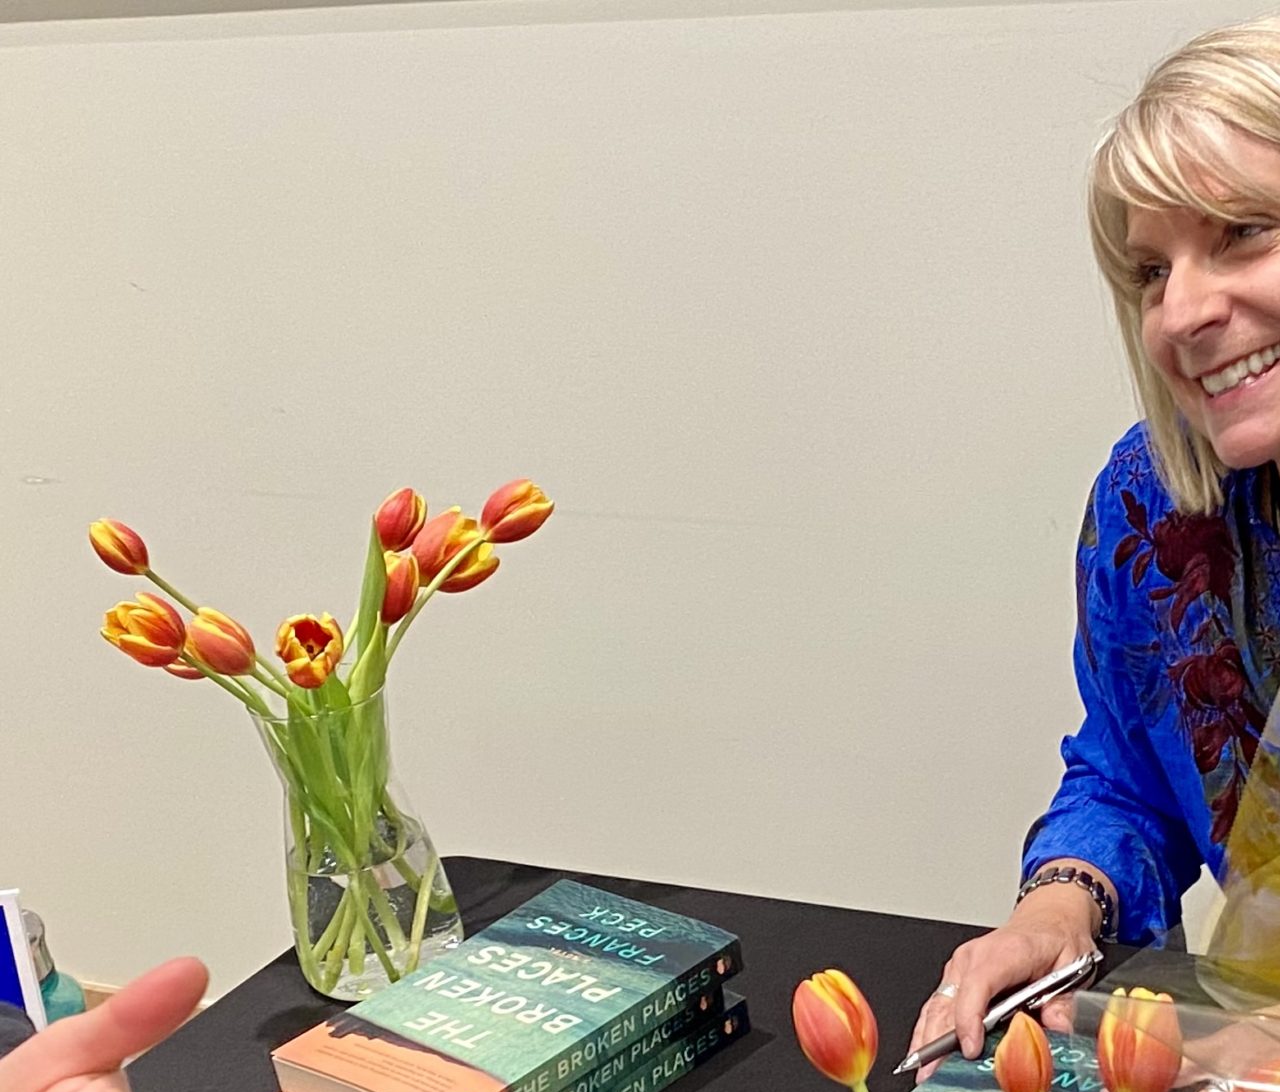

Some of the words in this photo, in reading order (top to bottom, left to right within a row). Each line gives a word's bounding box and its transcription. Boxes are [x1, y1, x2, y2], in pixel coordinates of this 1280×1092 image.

[526, 915, 666, 967] FRANCES
[579, 905, 666, 939] PECK
[413, 970, 583, 1035] BROKEN
[467, 945, 622, 1003] PLACES
[403, 1010, 492, 1050] THE
[557, 1015, 635, 1080] BROKEN
[642, 969, 711, 1026] PLACES
[652, 1026, 720, 1086] PLACES
